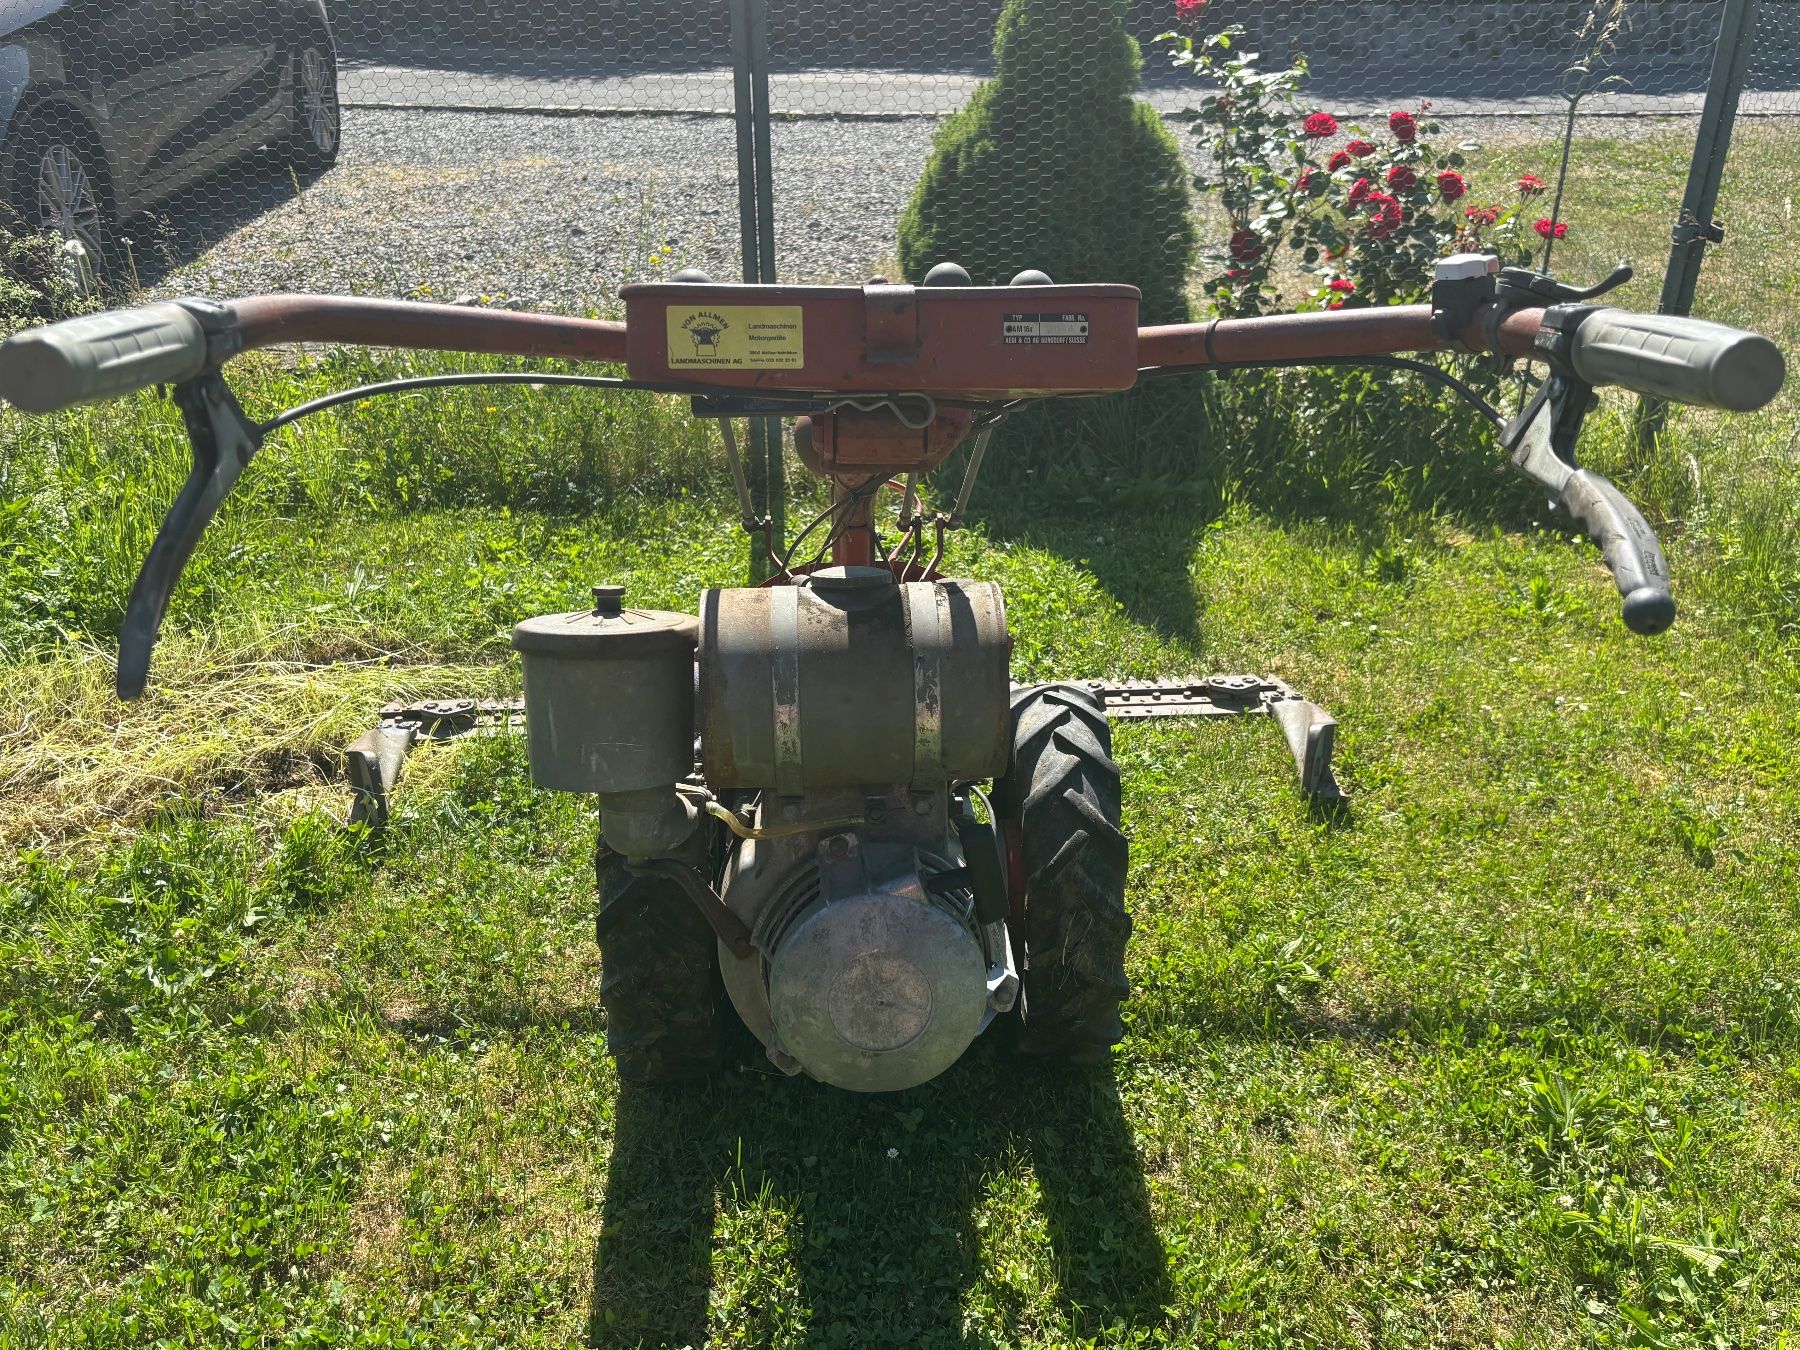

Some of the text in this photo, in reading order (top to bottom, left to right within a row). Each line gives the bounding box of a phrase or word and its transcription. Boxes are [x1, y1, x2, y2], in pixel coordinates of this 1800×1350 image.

[681, 311, 730, 330] VON ALLMEN
[1012, 325, 1023, 333] AM
